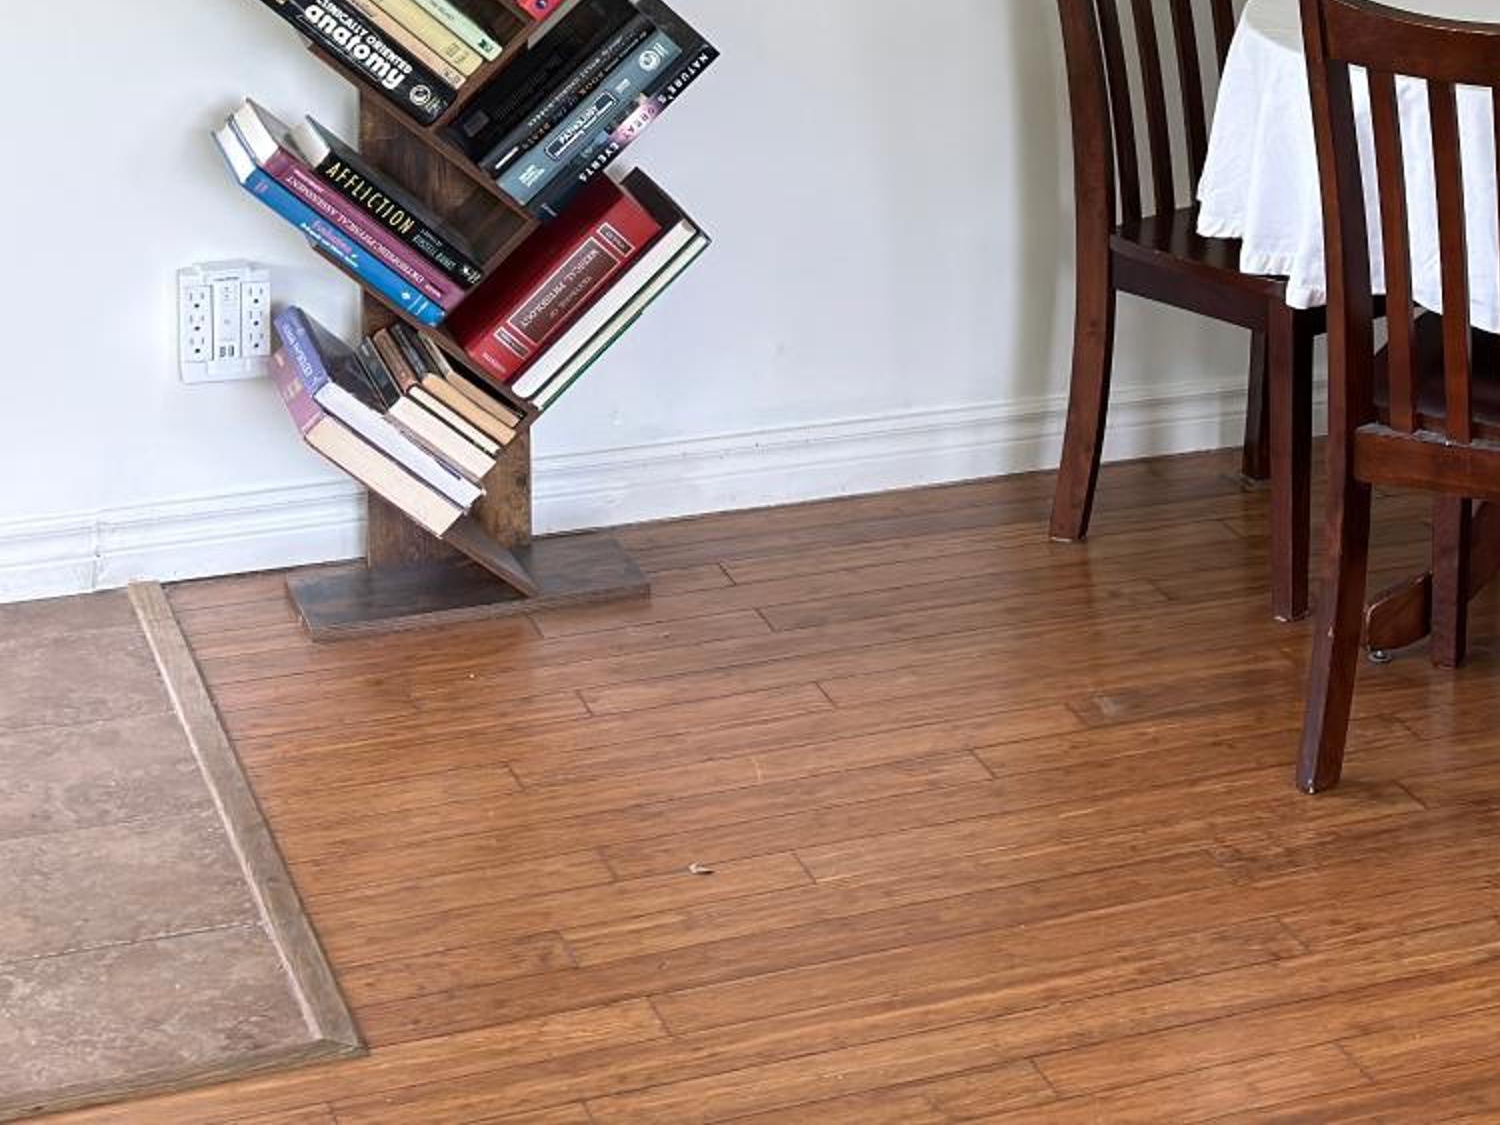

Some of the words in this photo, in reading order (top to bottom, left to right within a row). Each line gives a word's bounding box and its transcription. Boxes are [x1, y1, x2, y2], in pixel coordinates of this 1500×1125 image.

[304, 4, 406, 91] anatomy
[365, 35, 413, 75] ORIENTED
[656, 51, 710, 105] NATURE'S
[621, 105, 656, 140] GREAT
[578, 141, 620, 182] EVENTS
[325, 161, 415, 235] AFFLICTION
